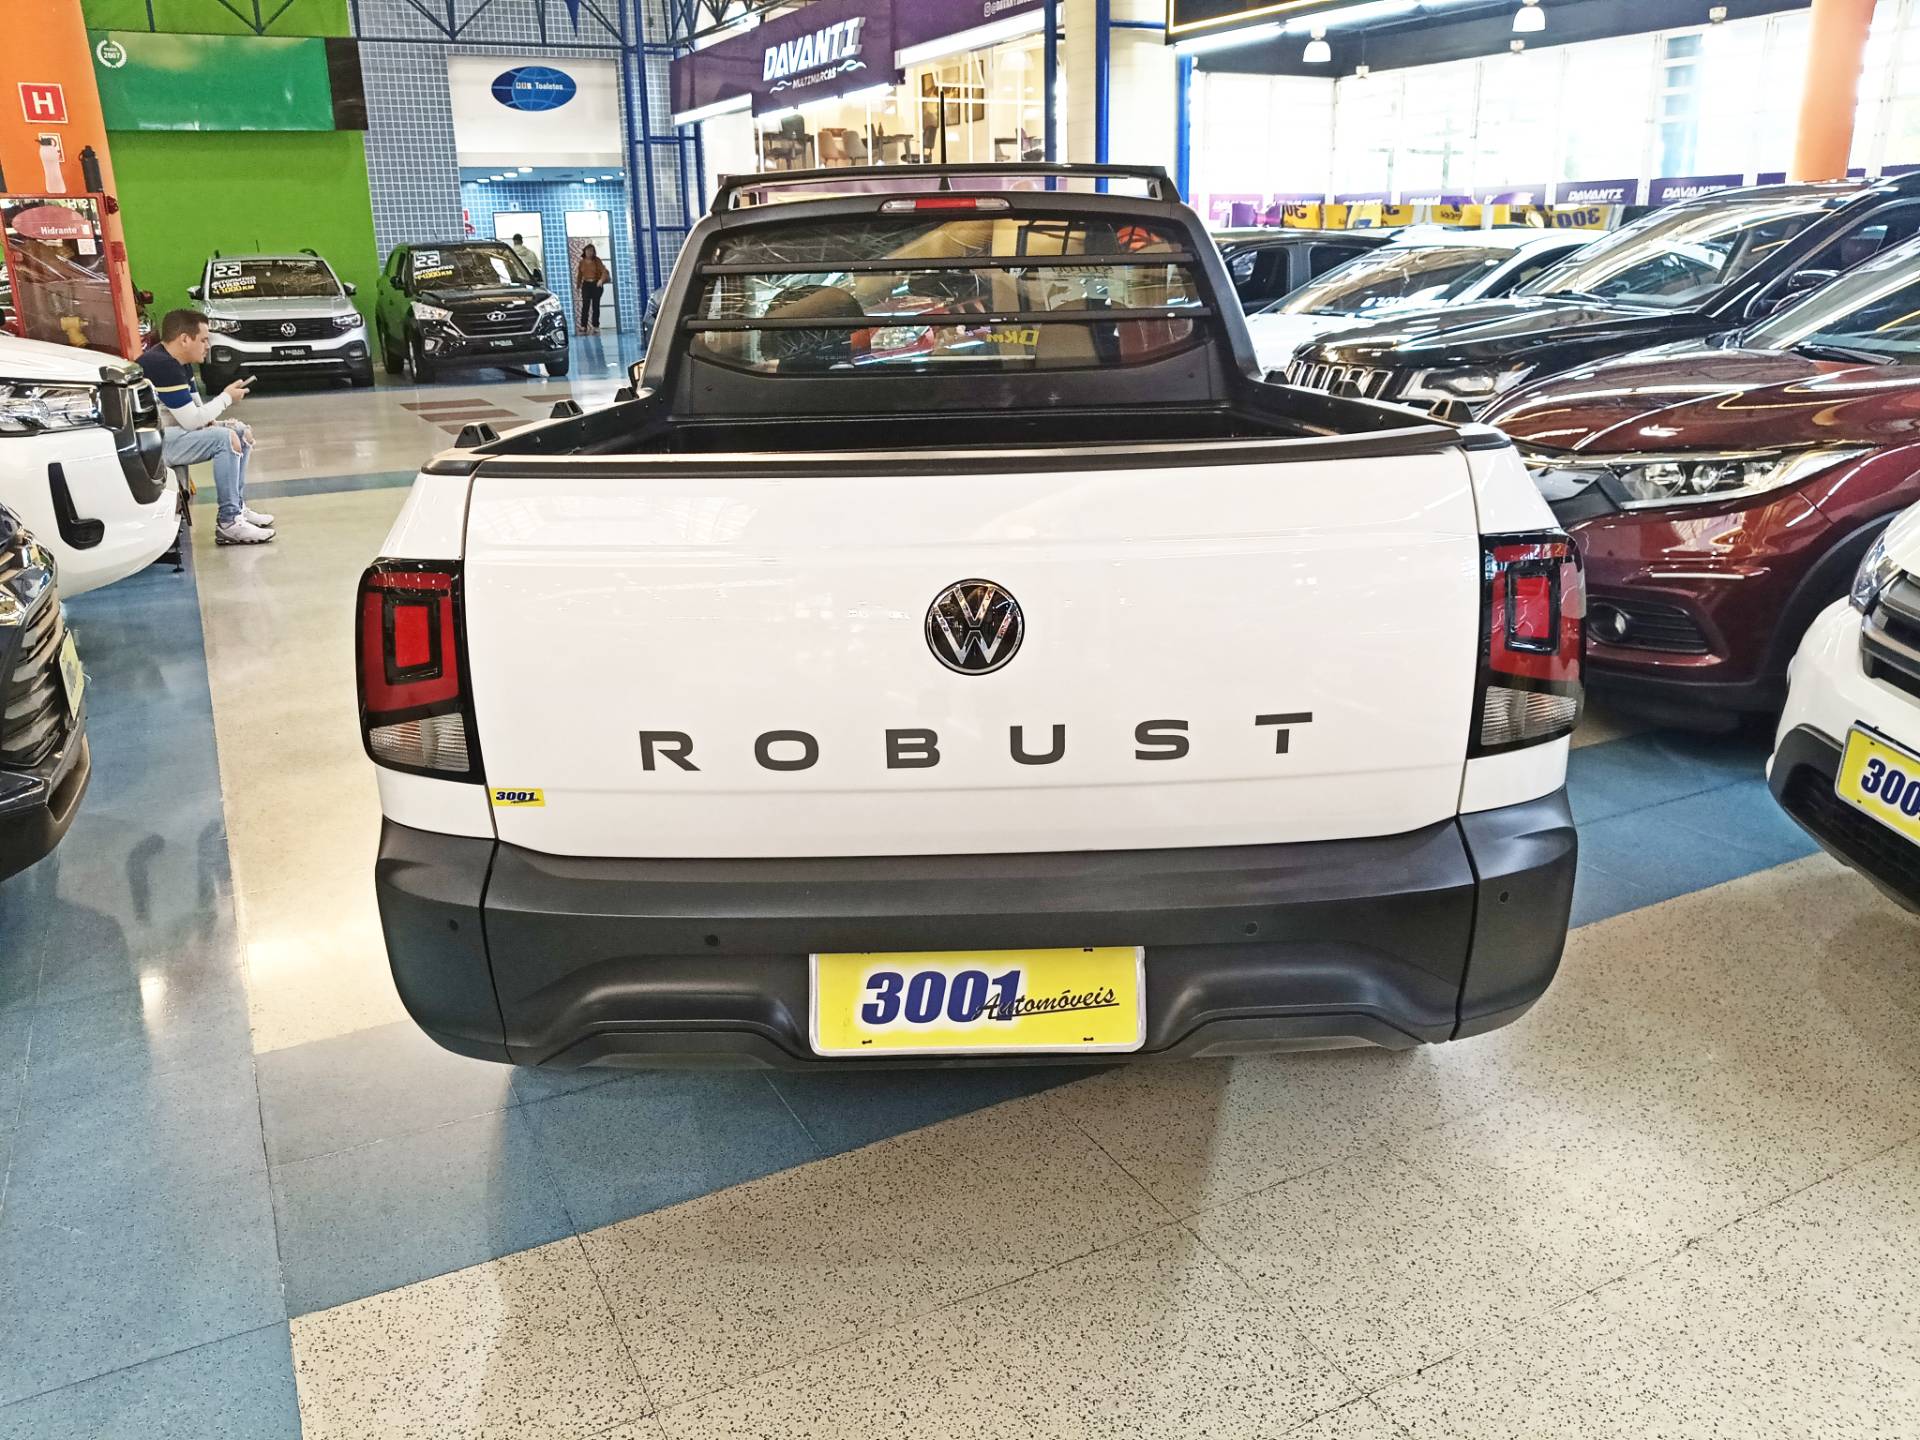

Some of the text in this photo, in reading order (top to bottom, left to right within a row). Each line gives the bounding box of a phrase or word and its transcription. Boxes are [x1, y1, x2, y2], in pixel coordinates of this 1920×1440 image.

[763, 17, 865, 81] DAVANTI
[792, 67, 837, 89] MULTIMARCAS
[32, 91, 55, 114] H
[1567, 188, 1625, 201] DAVANTI
[40, 227, 77, 235] Hidrante
[415, 255, 438, 266] 22
[215, 265, 240, 276] 22
[639, 712, 1313, 771] ROBUST
[496, 791, 535, 800] 3001
[861, 970, 1119, 1024] 3001 Automóveis
